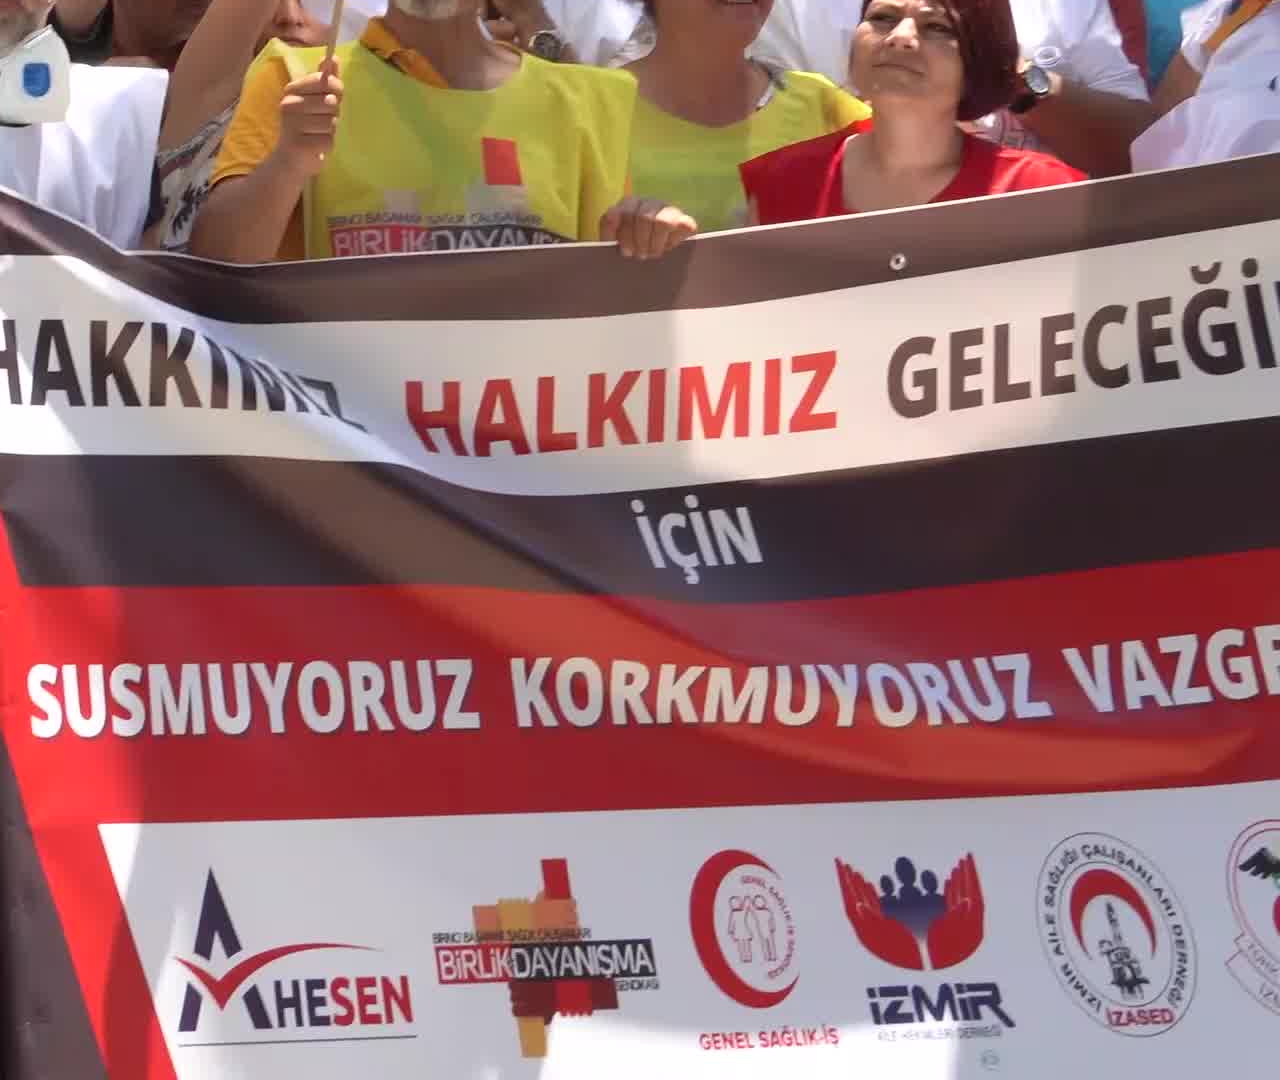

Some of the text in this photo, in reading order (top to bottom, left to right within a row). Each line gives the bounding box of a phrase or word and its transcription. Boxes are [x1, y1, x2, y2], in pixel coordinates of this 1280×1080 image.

[405, 350, 839, 458] HALKIMIZ
[887, 257, 1280, 419] GELECEĞİ
[631, 493, 763, 586] İÇİN
[26, 658, 481, 739] SUSMUYORUZ
[513, 651, 1053, 729] KORKMUYORUZ
[698, 1031, 755, 1051] GENEL
